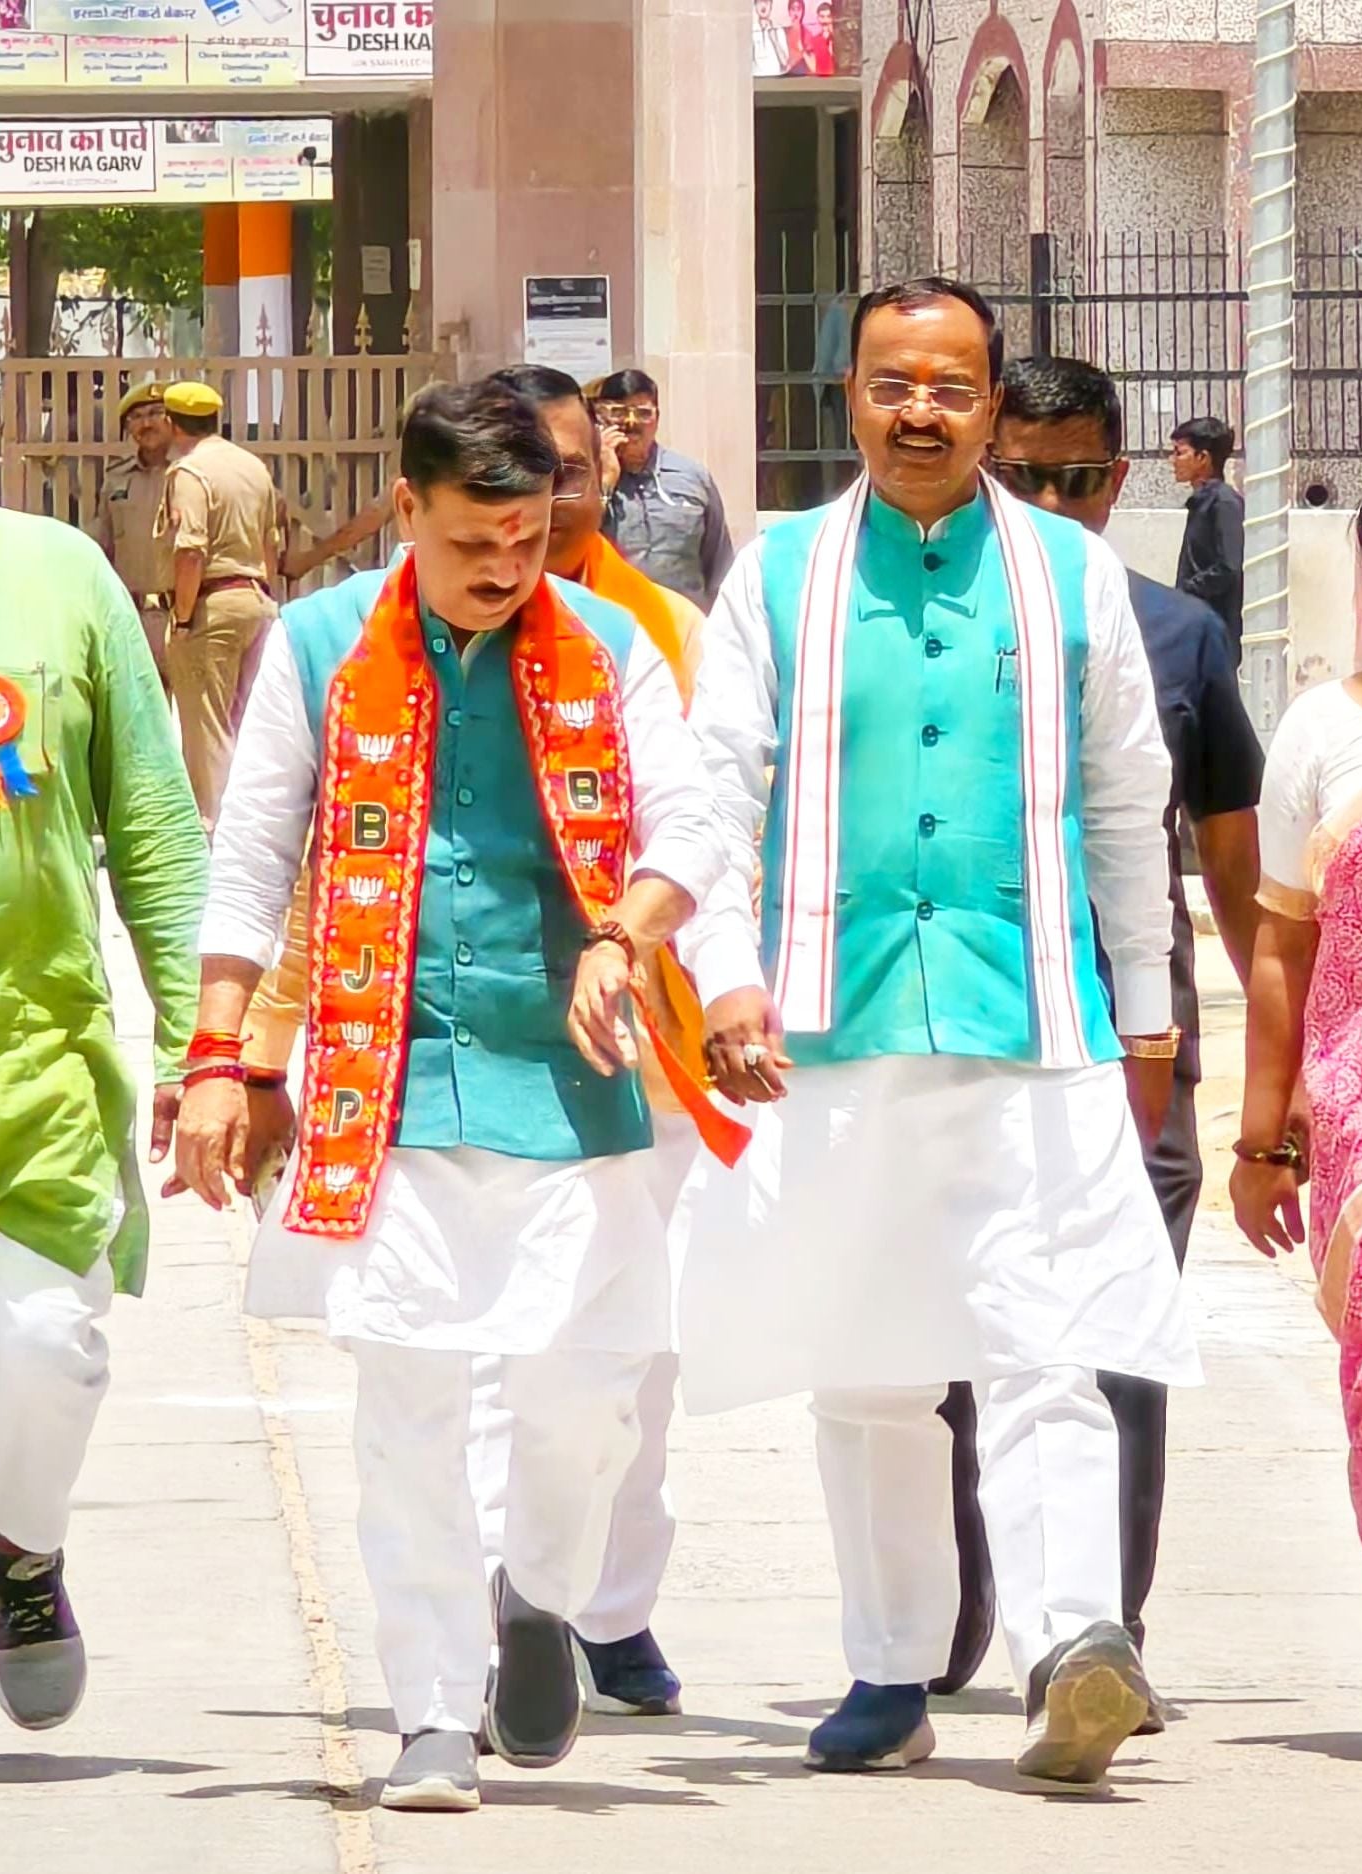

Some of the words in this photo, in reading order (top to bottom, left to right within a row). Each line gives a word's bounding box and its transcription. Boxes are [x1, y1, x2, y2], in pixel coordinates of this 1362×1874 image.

[311, 3, 397, 41] चुनाव
[403, 3, 433, 28] क
[347, 33, 399, 51] DESH
[404, 33, 432, 50] KA
[69, 129, 104, 152] का
[110, 120, 147, 151] पर्व
[24, 156, 65, 173] DESH
[69, 156, 93, 172] KA
[97, 155, 143, 172] GARV
[565, 768, 602, 811] B
